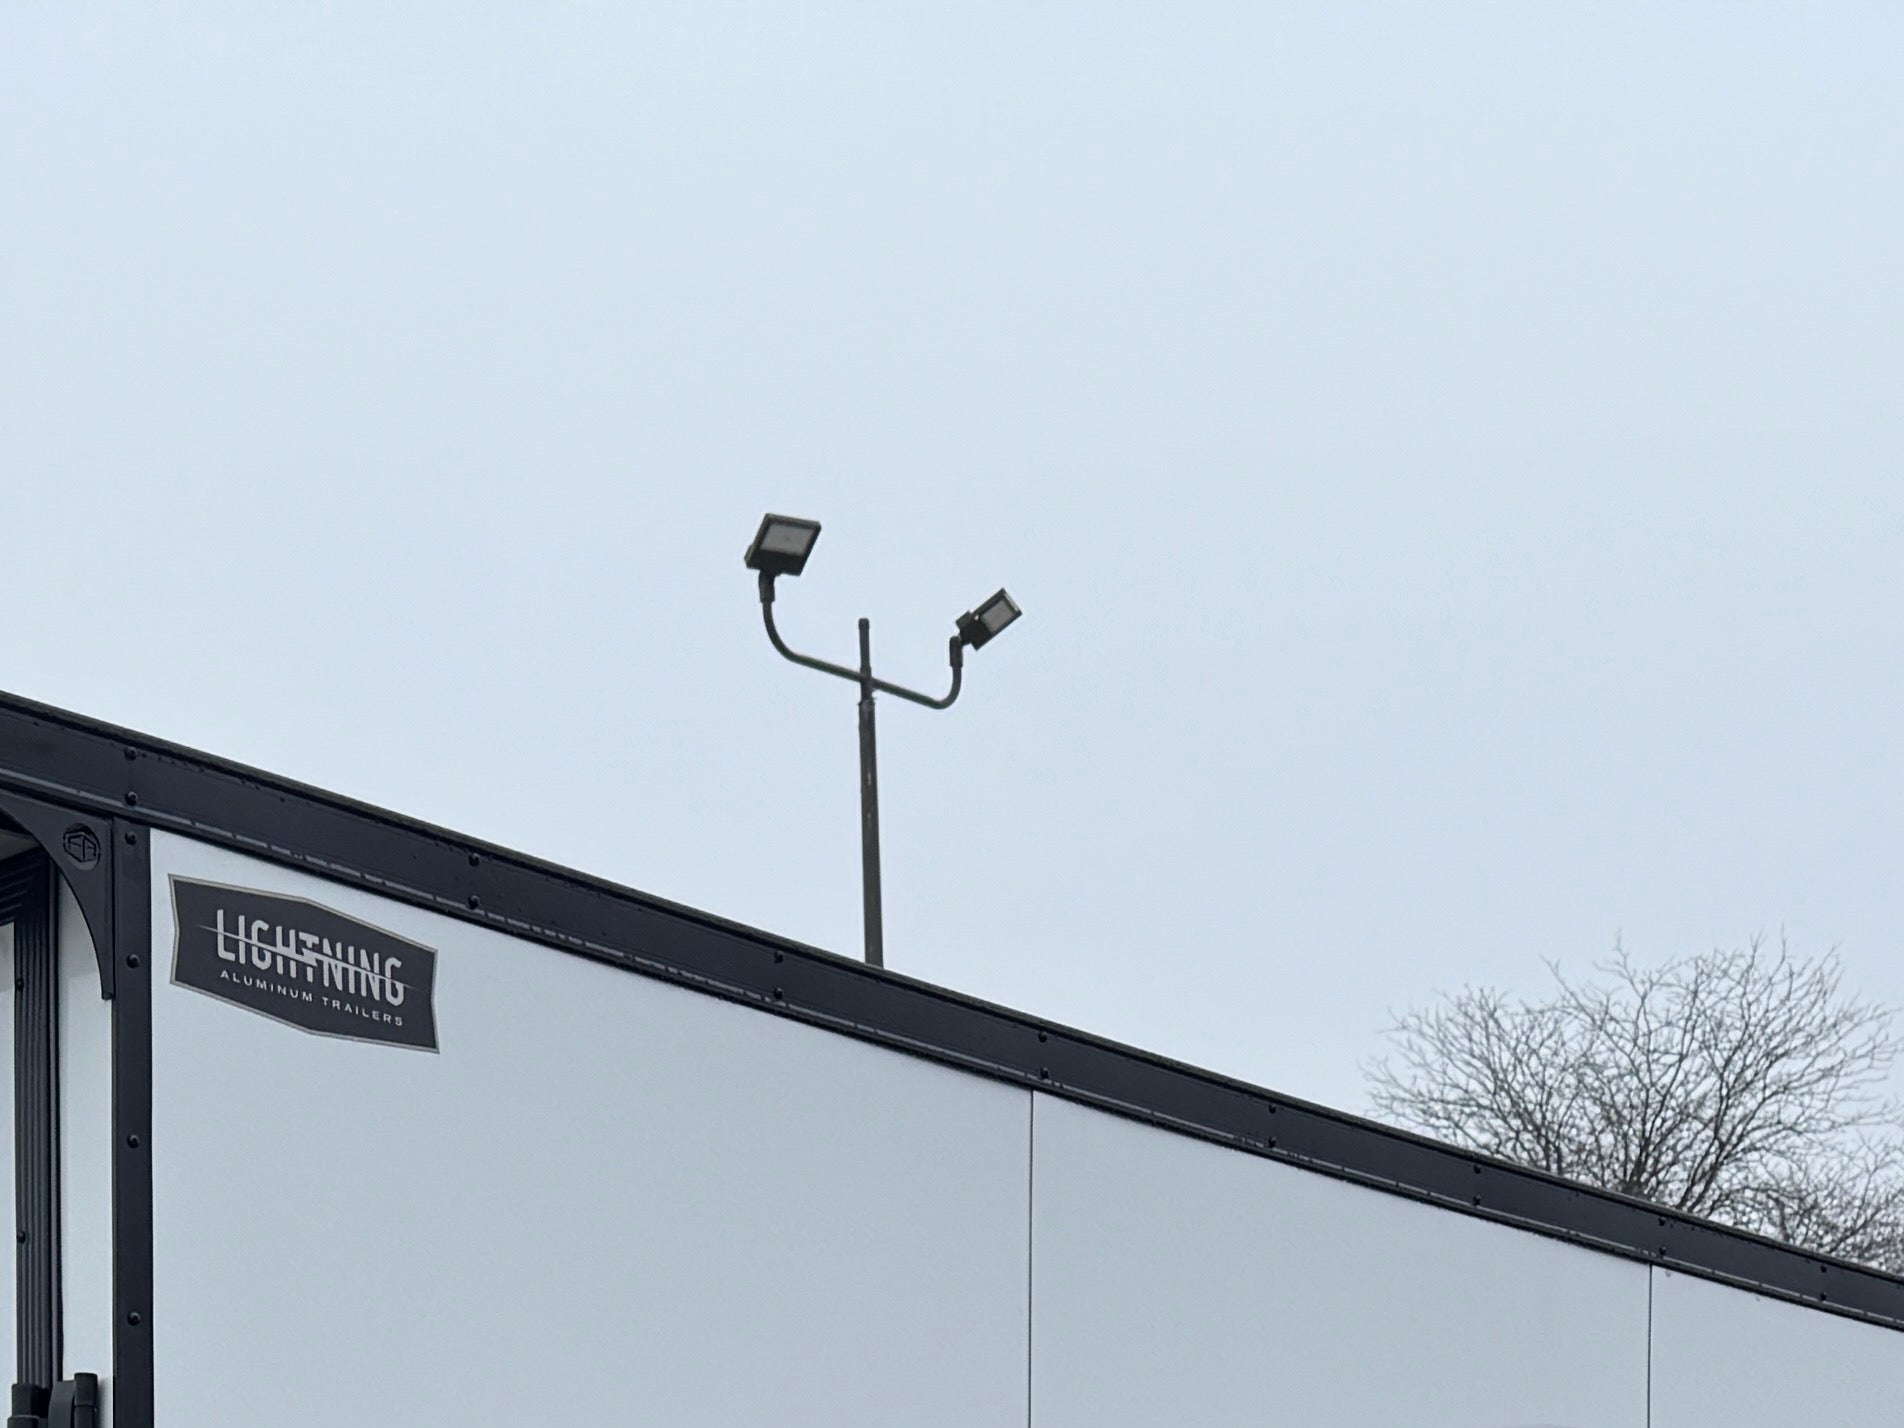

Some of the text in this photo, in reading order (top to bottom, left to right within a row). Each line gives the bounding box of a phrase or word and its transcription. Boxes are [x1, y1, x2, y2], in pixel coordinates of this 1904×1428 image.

[215, 908, 405, 1007] LIGHTNING
[220, 969, 404, 1027] ALUMINUM TRAILERS
